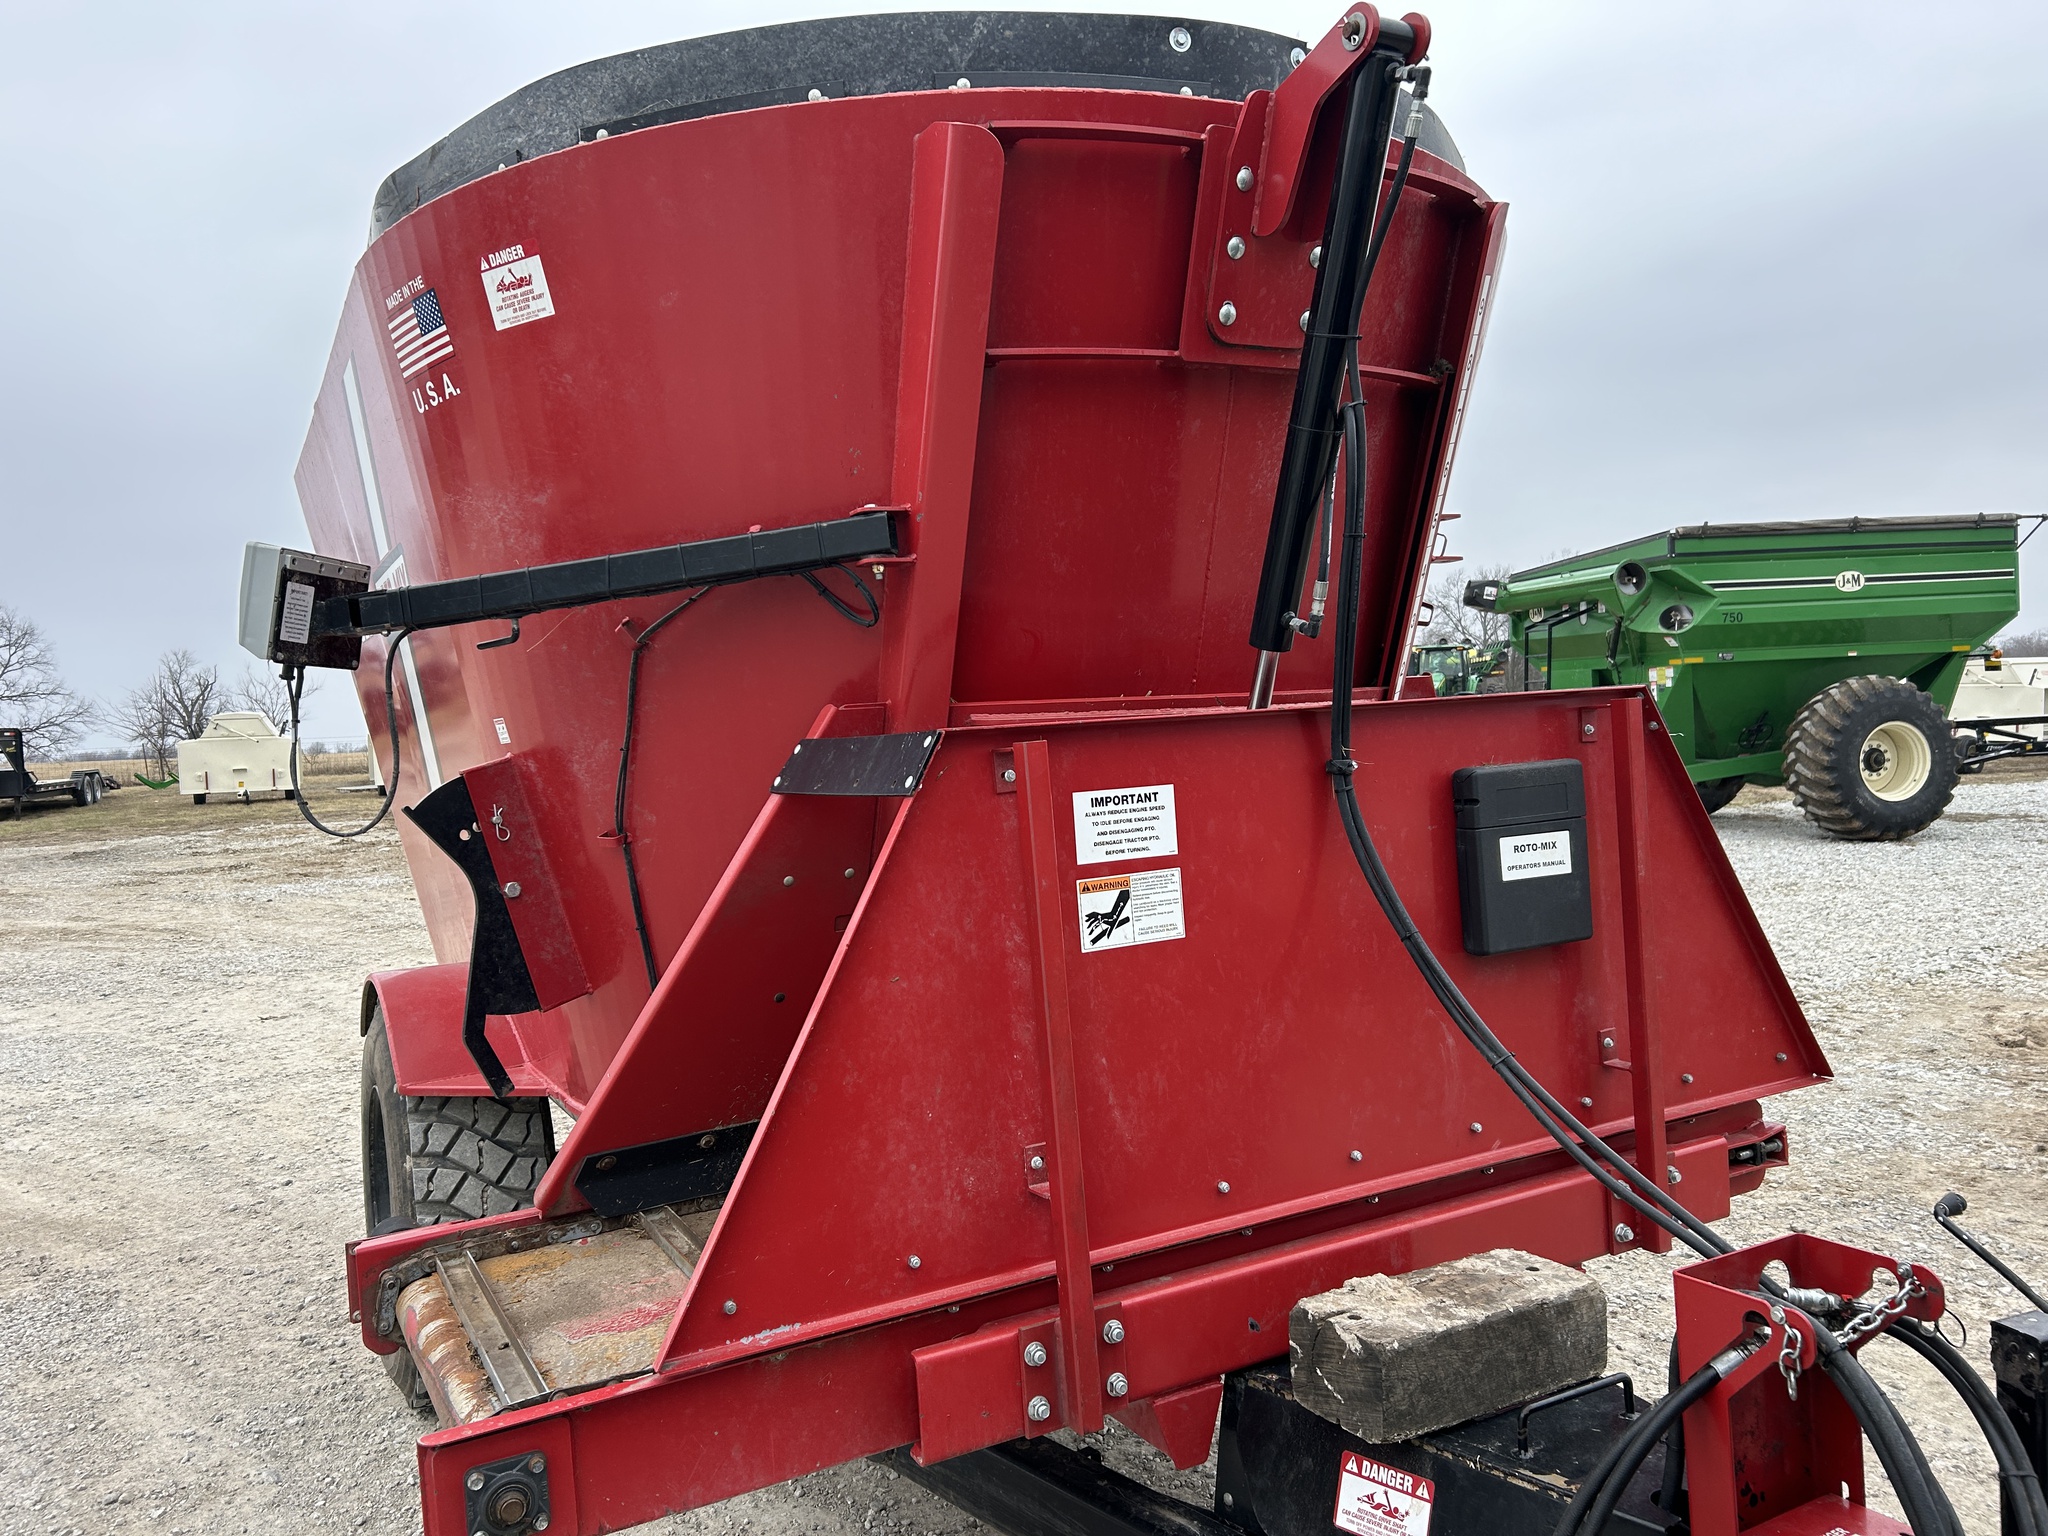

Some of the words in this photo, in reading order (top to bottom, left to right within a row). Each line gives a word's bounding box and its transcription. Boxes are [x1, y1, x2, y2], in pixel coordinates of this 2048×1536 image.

[488, 244, 525, 267] DANGER
[386, 289, 403, 311] MADE
[402, 284, 411, 299] IN
[408, 275, 425, 293] THE
[502, 293, 519, 303] ROTATING
[520, 288, 534, 297] AUGERS
[504, 301, 516, 309] CAUSE
[517, 297, 530, 305] SEVERE
[531, 292, 544, 301] INJURY
[1838, 574, 1861, 588] J&M
[1722, 612, 1743, 623] 750
[1091, 792, 1159, 808] IMPORTANT
[1109, 827, 1143, 835] DISENGAGING
[1514, 841, 1557, 853] ROTO-MIX
[1507, 862, 1541, 872] OPERATORS
[1091, 880, 1129, 891] WARNING
[1362, 1460, 1413, 1494] DANGER
[1342, 1508, 1350, 1516] CAN
[1352, 1512, 1366, 1522] CAUSE
[1367, 1518, 1383, 1529] SEVERE
[1383, 1525, 1399, 1535] INJURY
[1357, 1508, 1378, 1520] ROTATING
[1379, 1516, 1392, 1525] DRIVE
[1392, 1521, 1408, 1531] SHAFT
